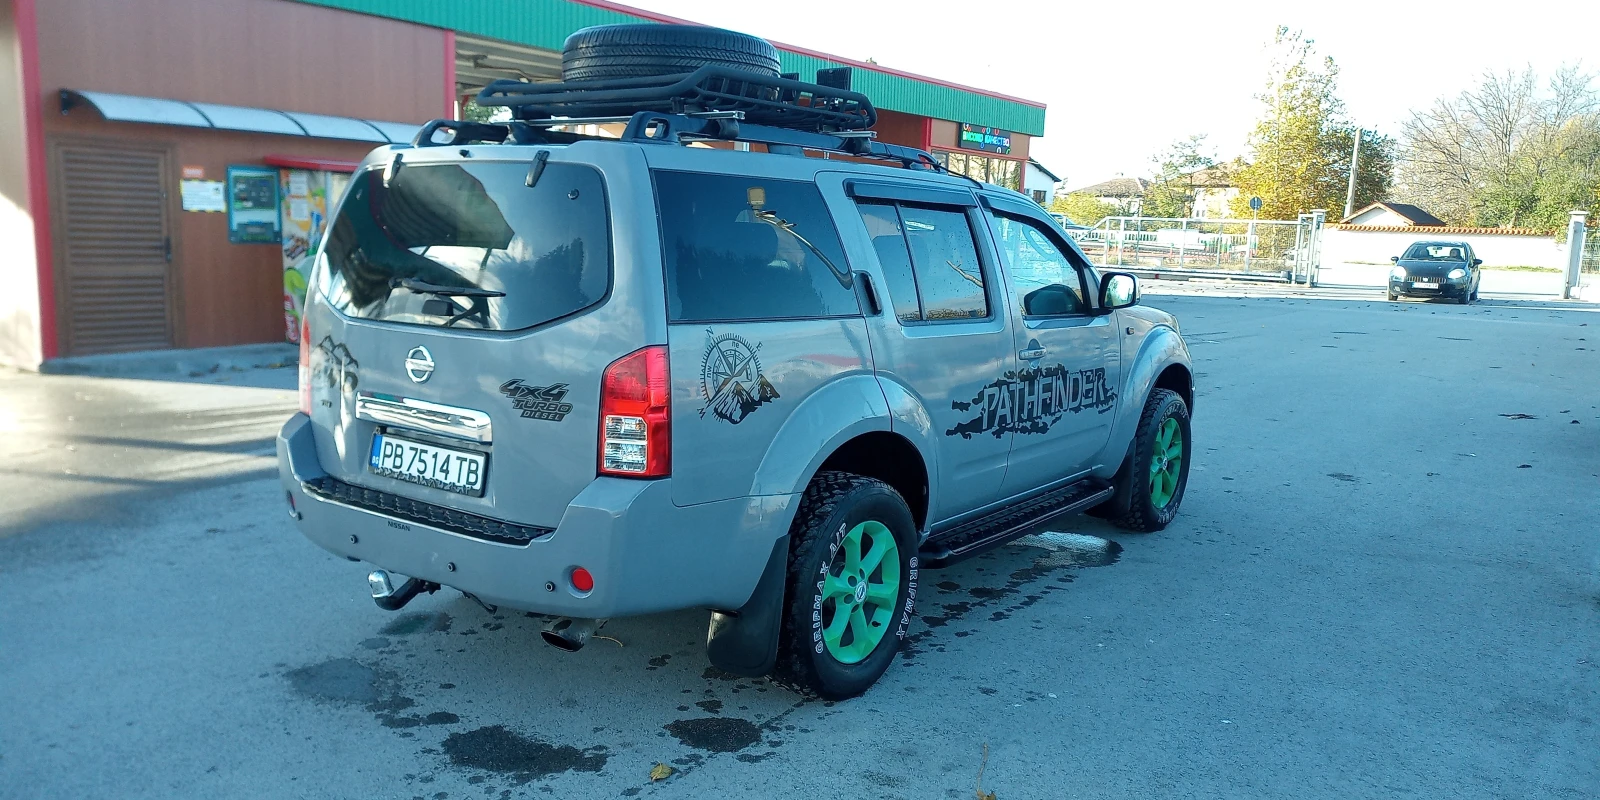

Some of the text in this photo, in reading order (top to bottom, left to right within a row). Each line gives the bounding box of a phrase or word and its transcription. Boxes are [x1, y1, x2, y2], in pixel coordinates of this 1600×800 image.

[512, 399, 573, 415] TURBO
[522, 410, 562, 421] DIESEL
[982, 370, 1107, 430] PATHFINDER
[387, 520, 411, 532] NISSAN
[812, 561, 830, 654] GRIPMAX
[895, 556, 918, 640] GRIPMAX
